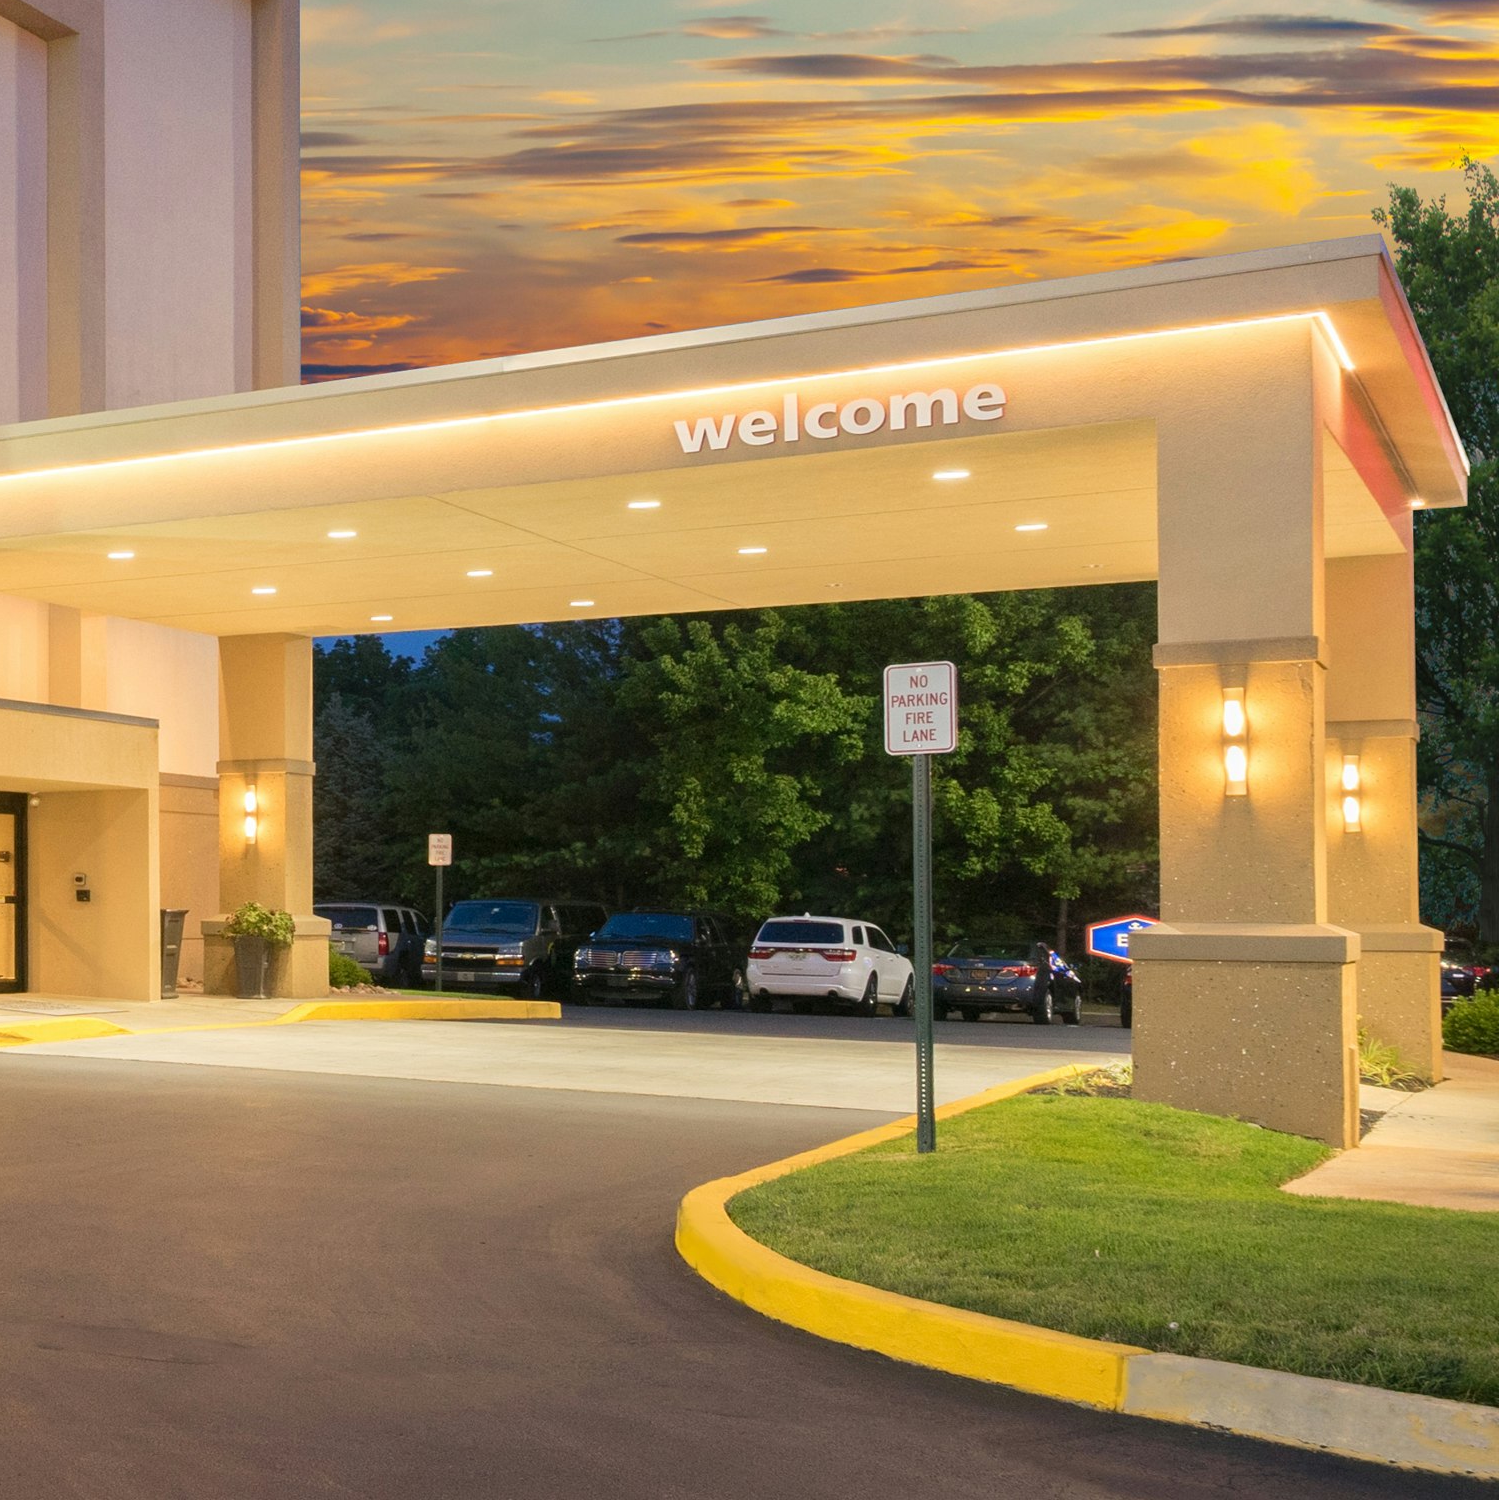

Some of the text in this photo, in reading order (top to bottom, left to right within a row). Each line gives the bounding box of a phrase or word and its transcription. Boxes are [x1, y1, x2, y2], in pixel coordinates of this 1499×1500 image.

[673, 383, 1007, 453] welcome
[909, 674, 929, 689] NO
[891, 692, 948, 708] PARKING
[905, 711, 934, 725] FIRE
[903, 728, 937, 743] LANE
